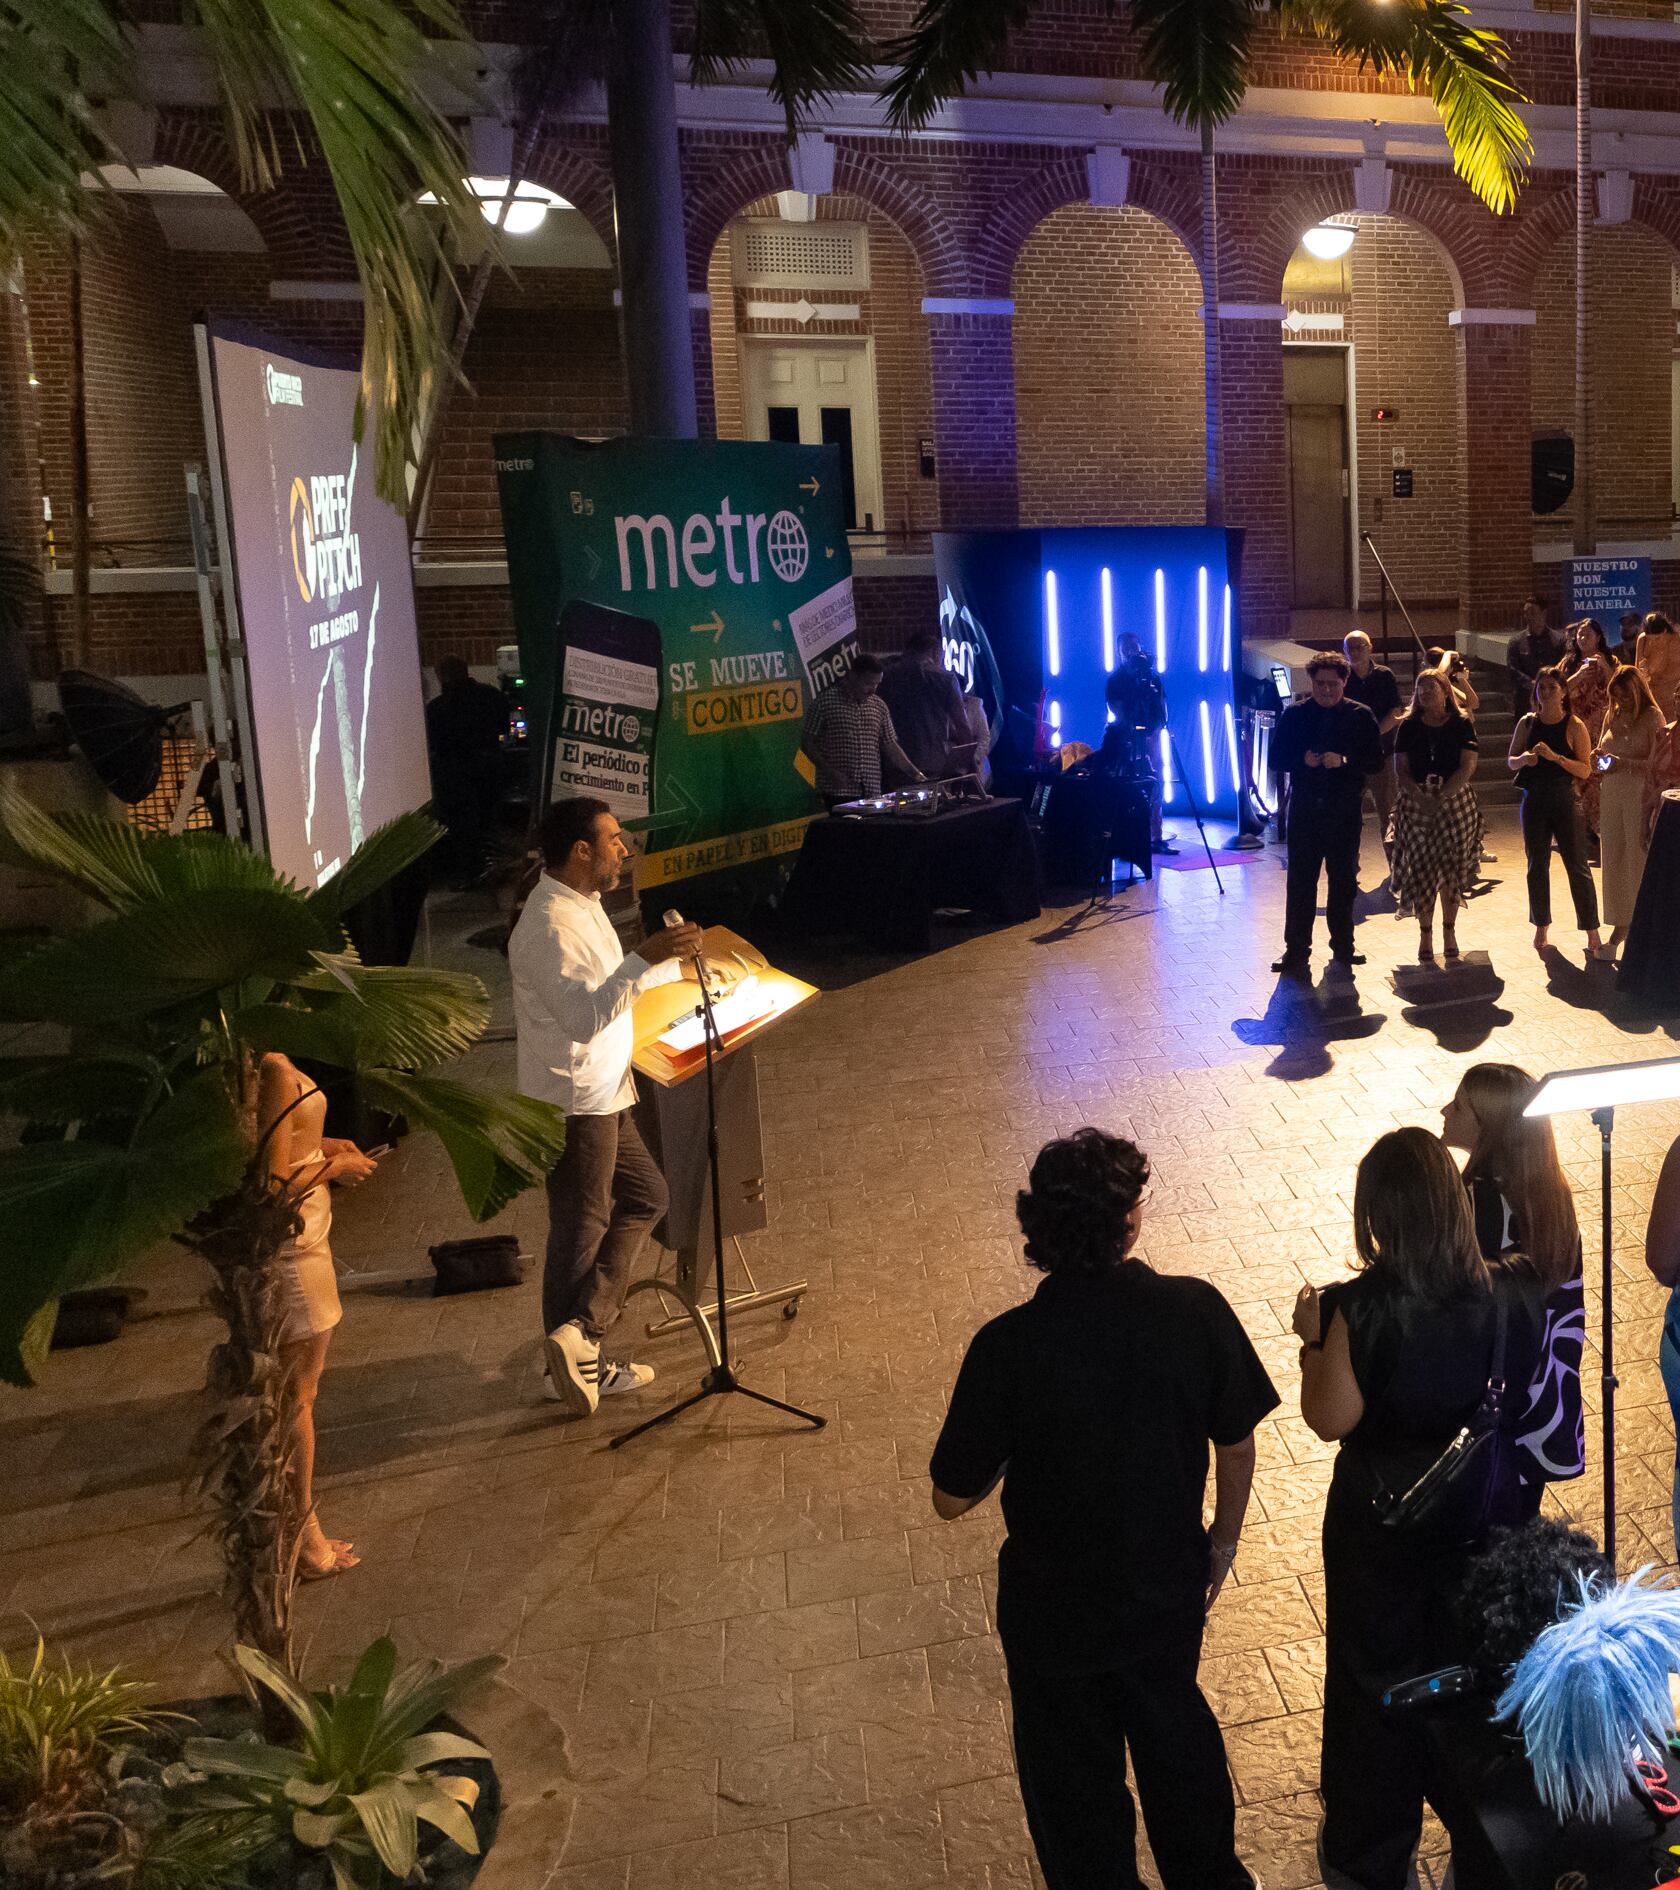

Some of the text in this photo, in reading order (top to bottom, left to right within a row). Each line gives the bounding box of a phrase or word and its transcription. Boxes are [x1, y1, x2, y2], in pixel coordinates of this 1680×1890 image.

[310, 474, 346, 535] PRFF
[614, 496, 809, 591] metro
[1573, 560, 1638, 572] NUESTRO
[1573, 575, 1606, 585] DON.
[1573, 586, 1637, 598] NUESTRA
[1573, 599, 1636, 611] MANERA.
[309, 610, 359, 650] 17 DE AGOSTO
[669, 661, 699, 692] SE
[710, 651, 788, 687] MUEVE
[812, 641, 861, 692] metr
[562, 705, 640, 742] metro
[692, 687, 798, 728] CONTIGO
[563, 742, 580, 763] El
[582, 749, 641, 775] periódico
[560, 771, 625, 793] crecimiento
[626, 783, 640, 795] en
[663, 855, 682, 875] EN
[686, 843, 731, 869] PAPEL
